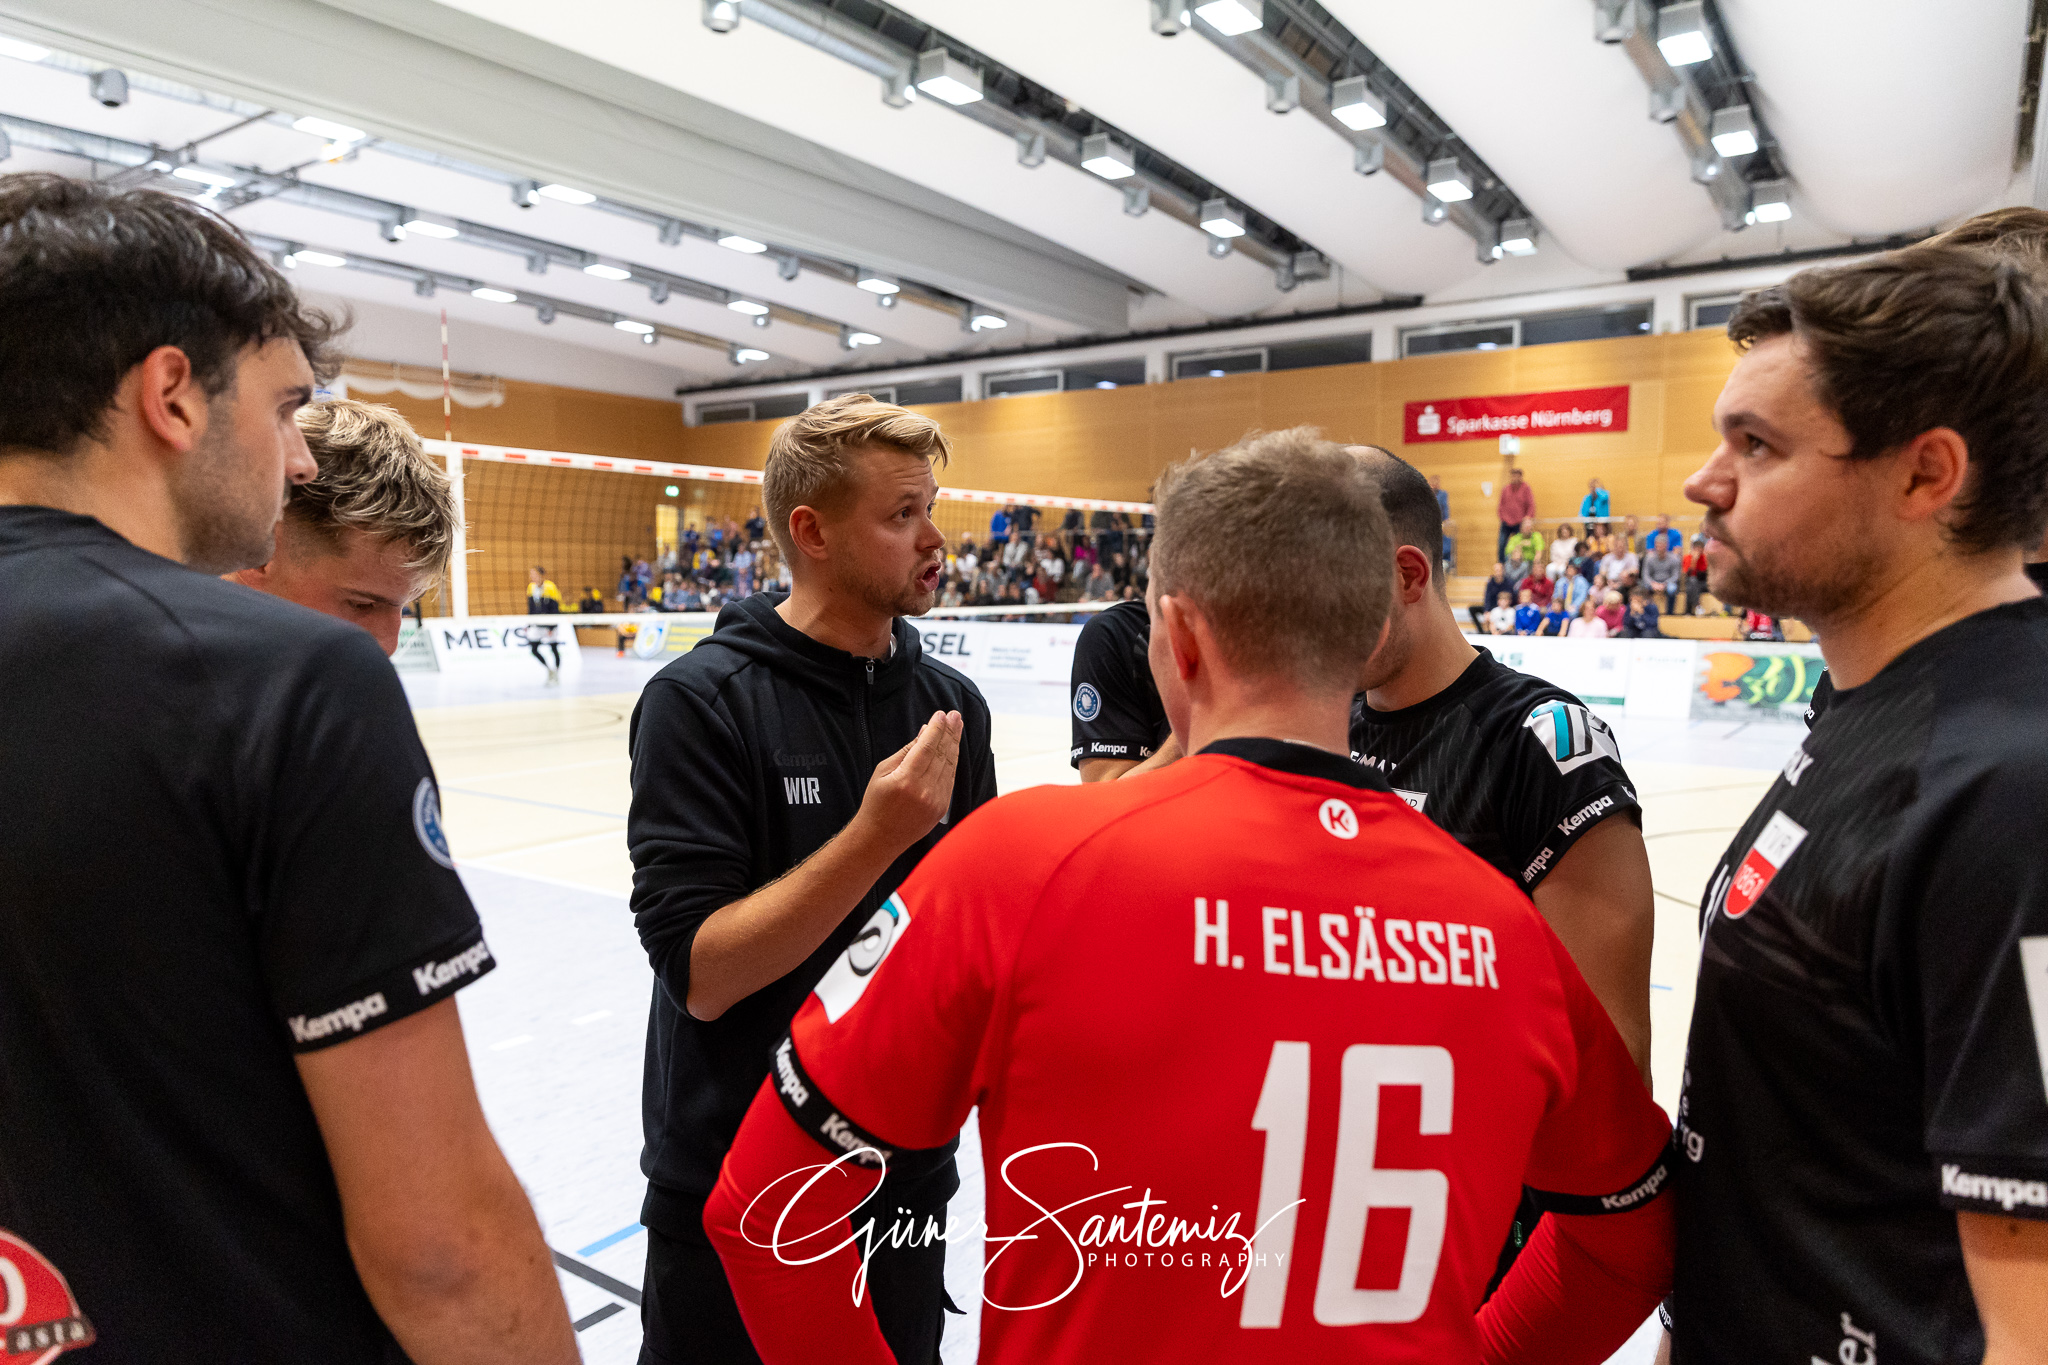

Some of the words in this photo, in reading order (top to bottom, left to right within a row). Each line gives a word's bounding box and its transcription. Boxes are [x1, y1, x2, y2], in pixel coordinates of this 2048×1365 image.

[1446, 413, 1530, 436] Sparkasse
[1531, 407, 1613, 428] Nürnberg
[920, 632, 971, 656] SEL
[773, 748, 829, 771] Kempa
[1091, 742, 1127, 755] Kempa
[783, 777, 822, 805] WIR
[1557, 795, 1615, 836] Kempa
[1521, 847, 1554, 883] empa
[1194, 897, 1244, 970] H.
[1262, 905, 1500, 990] ELSÄSSER
[287, 992, 388, 1043] Kempa
[775, 1037, 810, 1108] Kempa
[1239, 1040, 1455, 1330] 16
[1601, 1164, 1668, 1209] Kempa
[1941, 1156, 2048, 1211] Kempa
